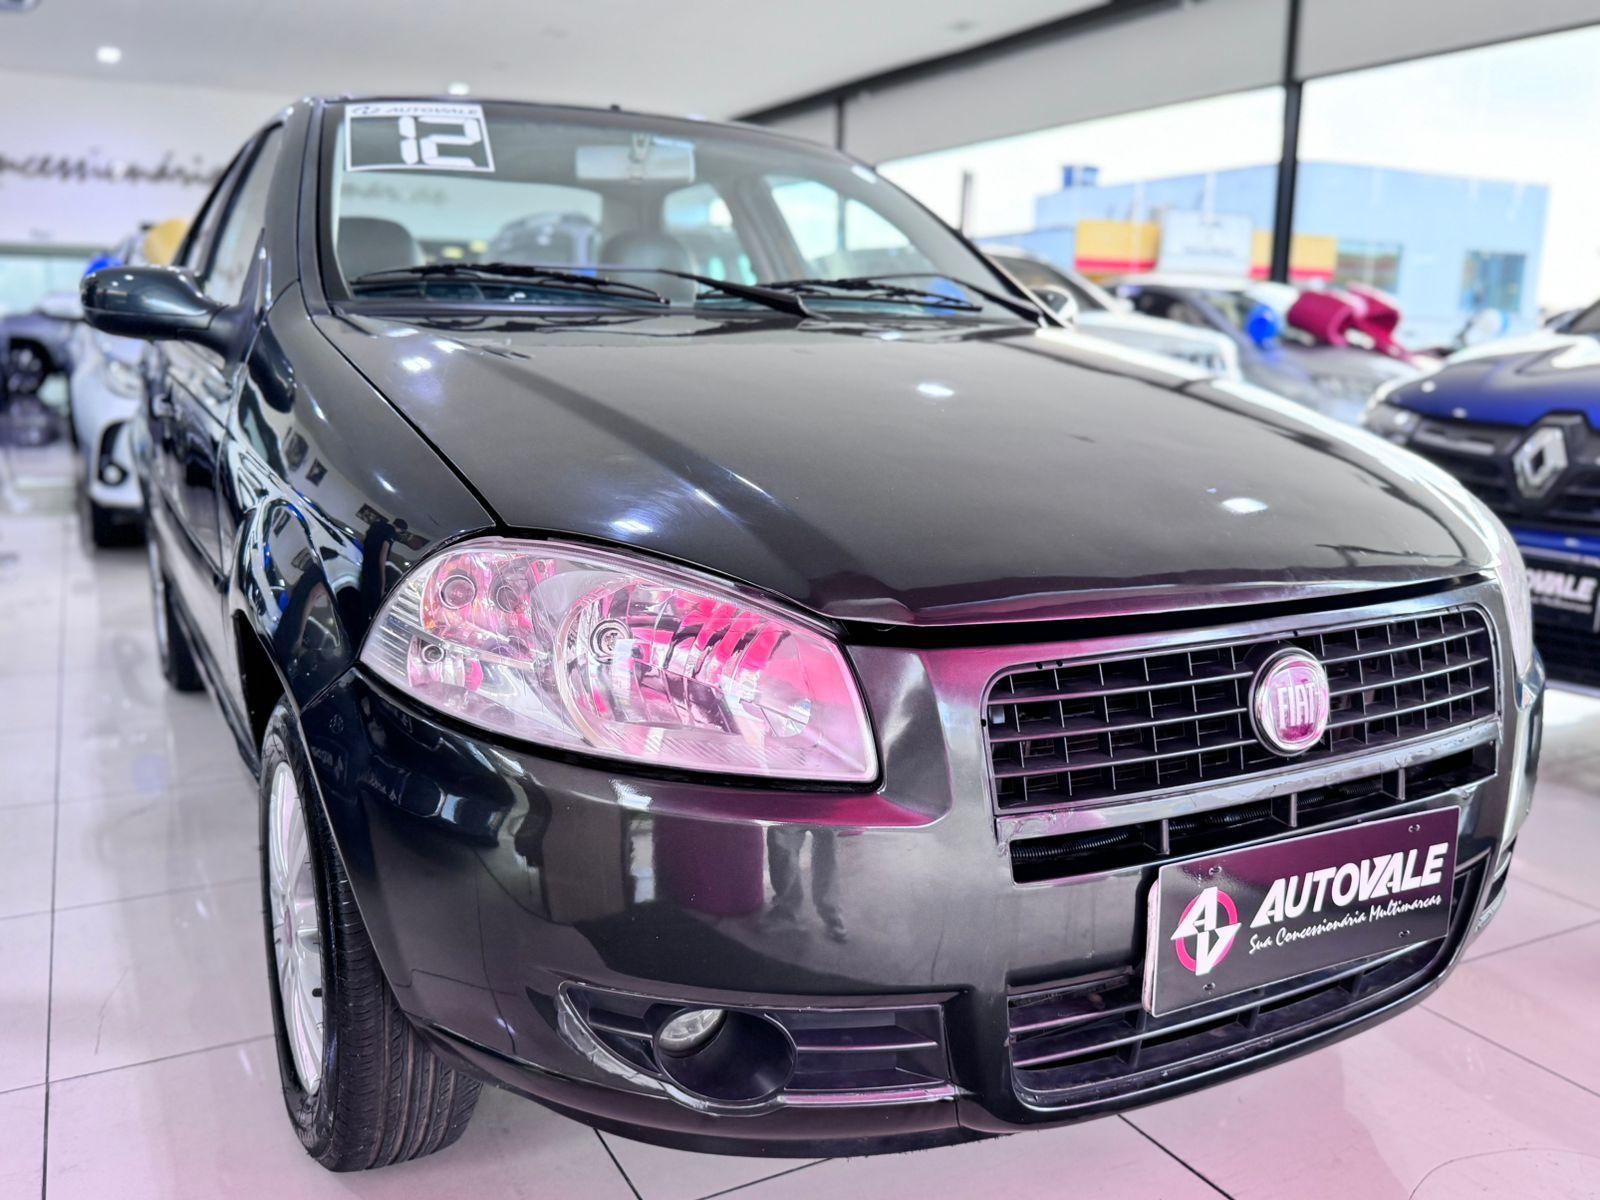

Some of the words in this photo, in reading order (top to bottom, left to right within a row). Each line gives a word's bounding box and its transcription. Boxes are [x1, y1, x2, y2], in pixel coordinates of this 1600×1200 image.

[398, 116, 481, 167] 12
[1277, 681, 1318, 730] FIAT
[1250, 842, 1449, 928] AUTOVALE
[1249, 933, 1273, 954] Sua
[1275, 911, 1366, 947] Concessionária
[1369, 894, 1443, 922] Multimarcas
